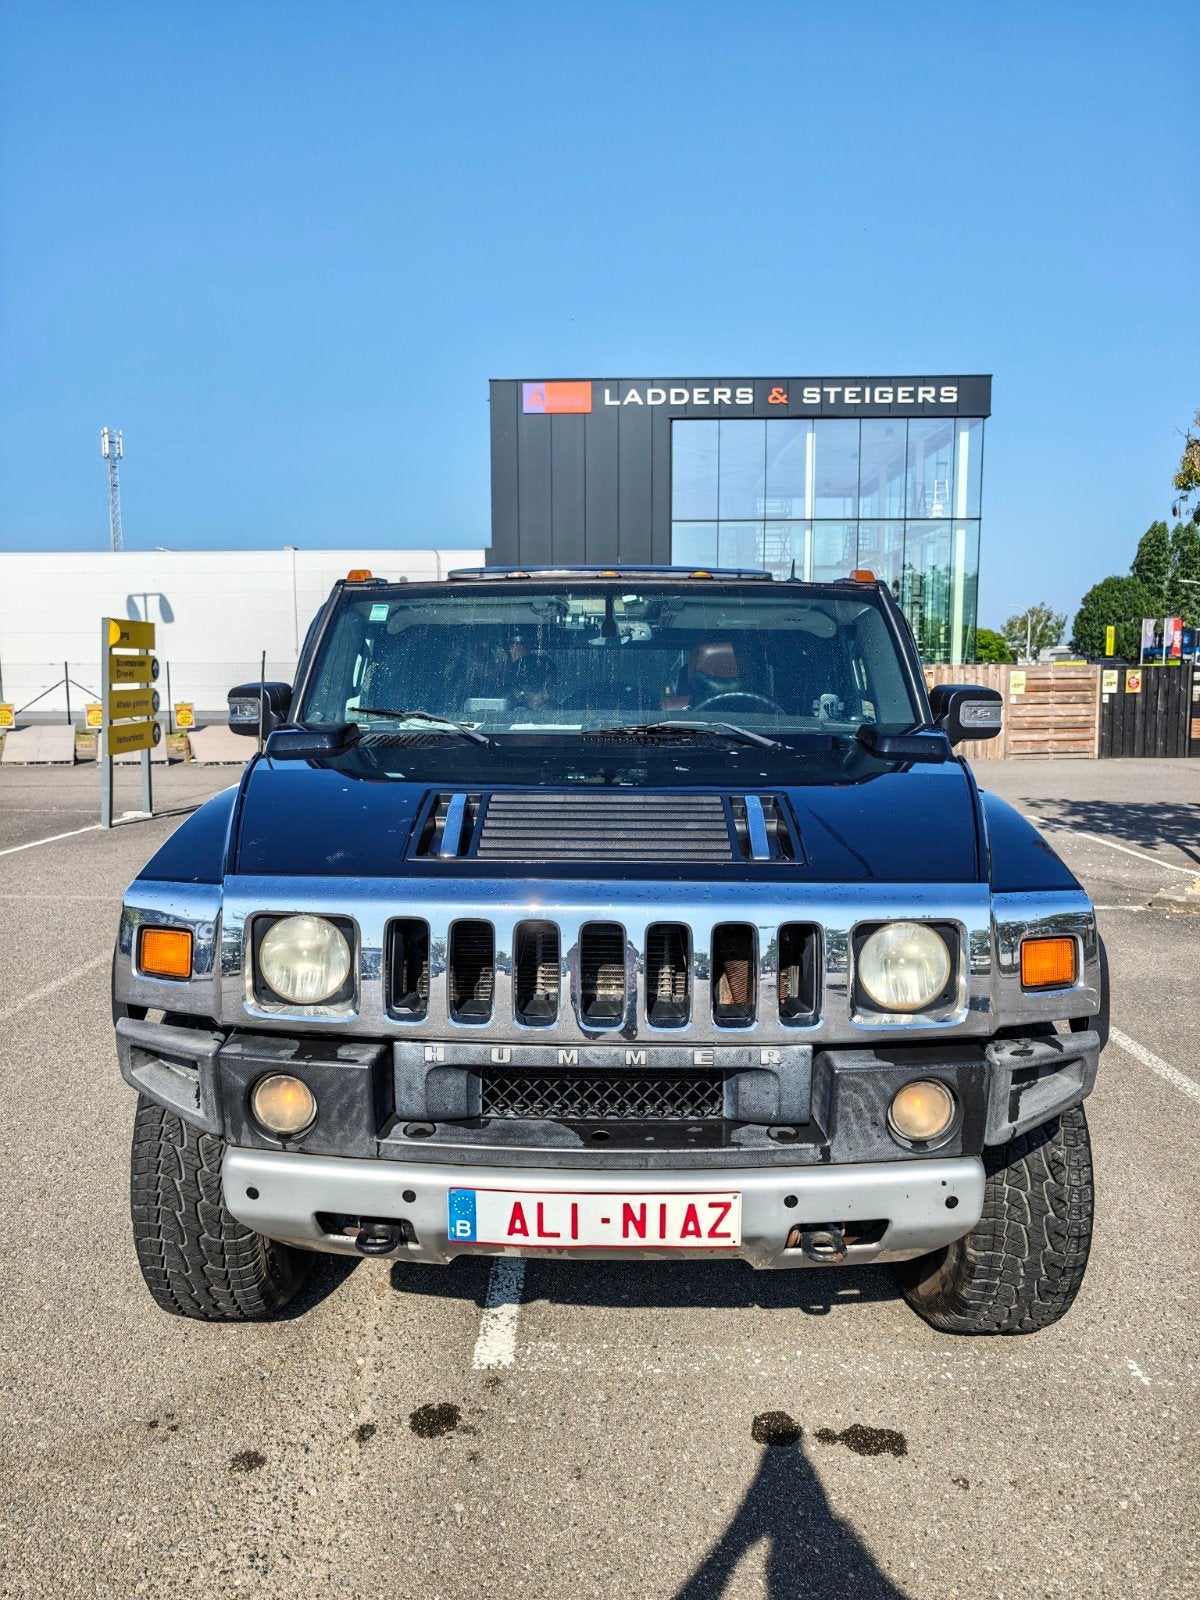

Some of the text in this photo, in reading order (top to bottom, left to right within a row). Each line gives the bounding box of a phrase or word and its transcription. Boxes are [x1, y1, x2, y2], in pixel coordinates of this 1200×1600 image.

[604, 388, 754, 406] LADDERS
[768, 386, 789, 404] &
[802, 386, 958, 404] STEIGERS
[423, 1045, 782, 1066] HUMMER
[455, 1219, 472, 1237] B
